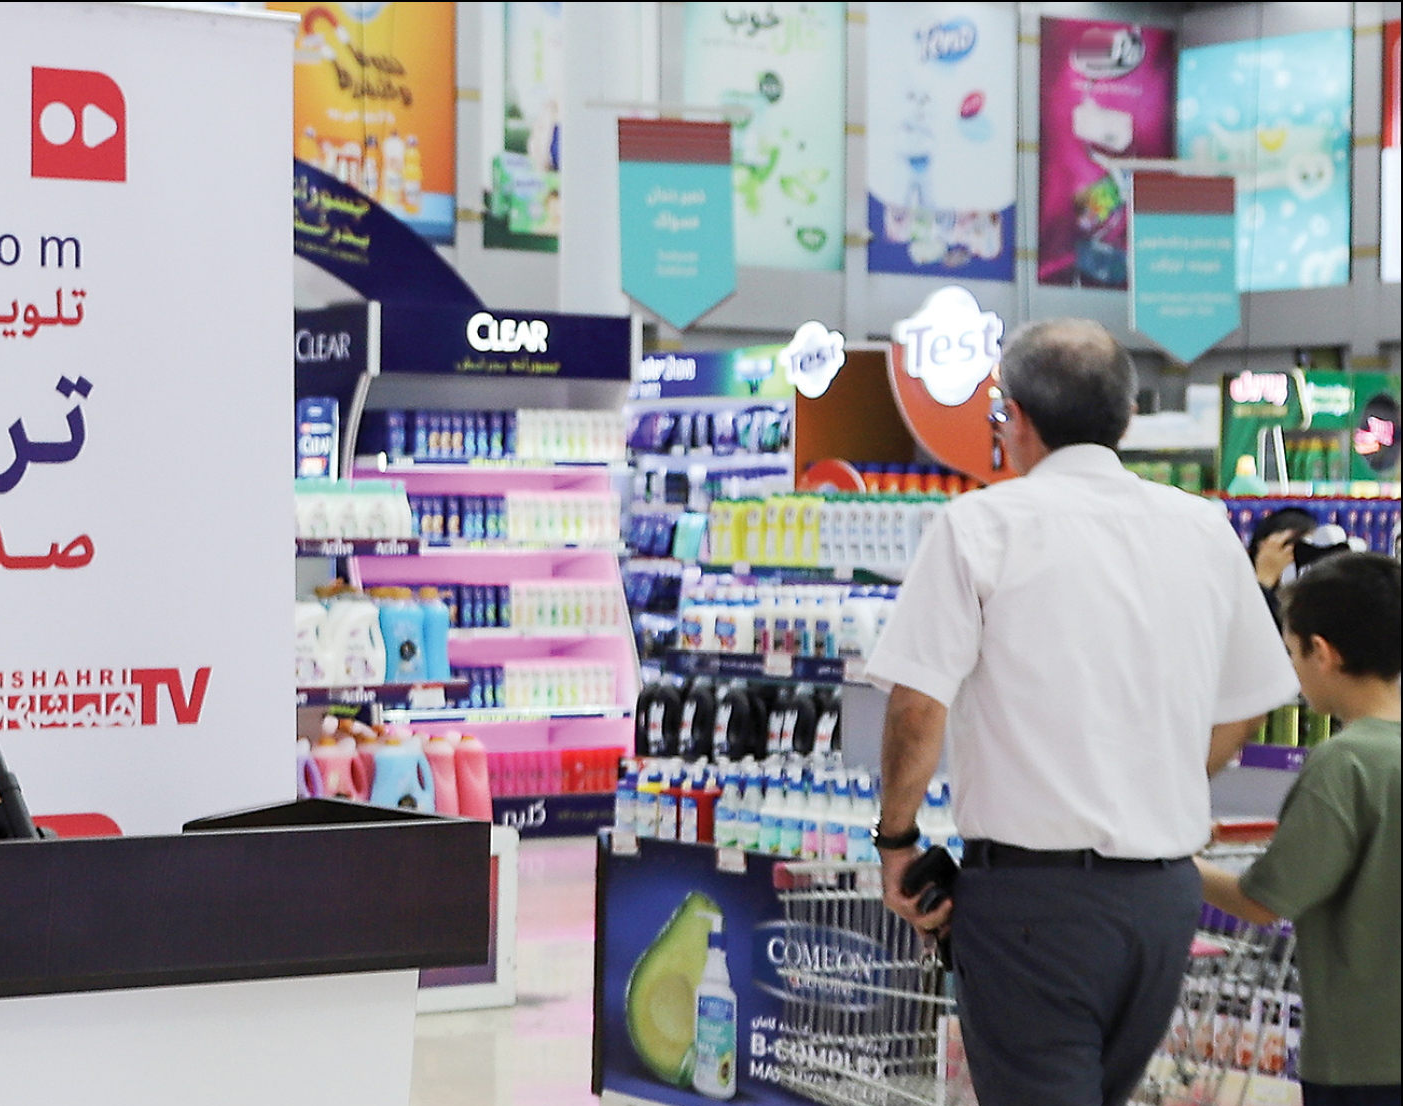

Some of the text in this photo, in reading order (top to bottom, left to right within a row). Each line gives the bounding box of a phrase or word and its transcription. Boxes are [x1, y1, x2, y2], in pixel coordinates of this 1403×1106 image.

[296, 330, 351, 363] CLEAR
[466, 312, 549, 352] CLEAR
[905, 322, 998, 369] Test
[131, 667, 212, 726] TV
